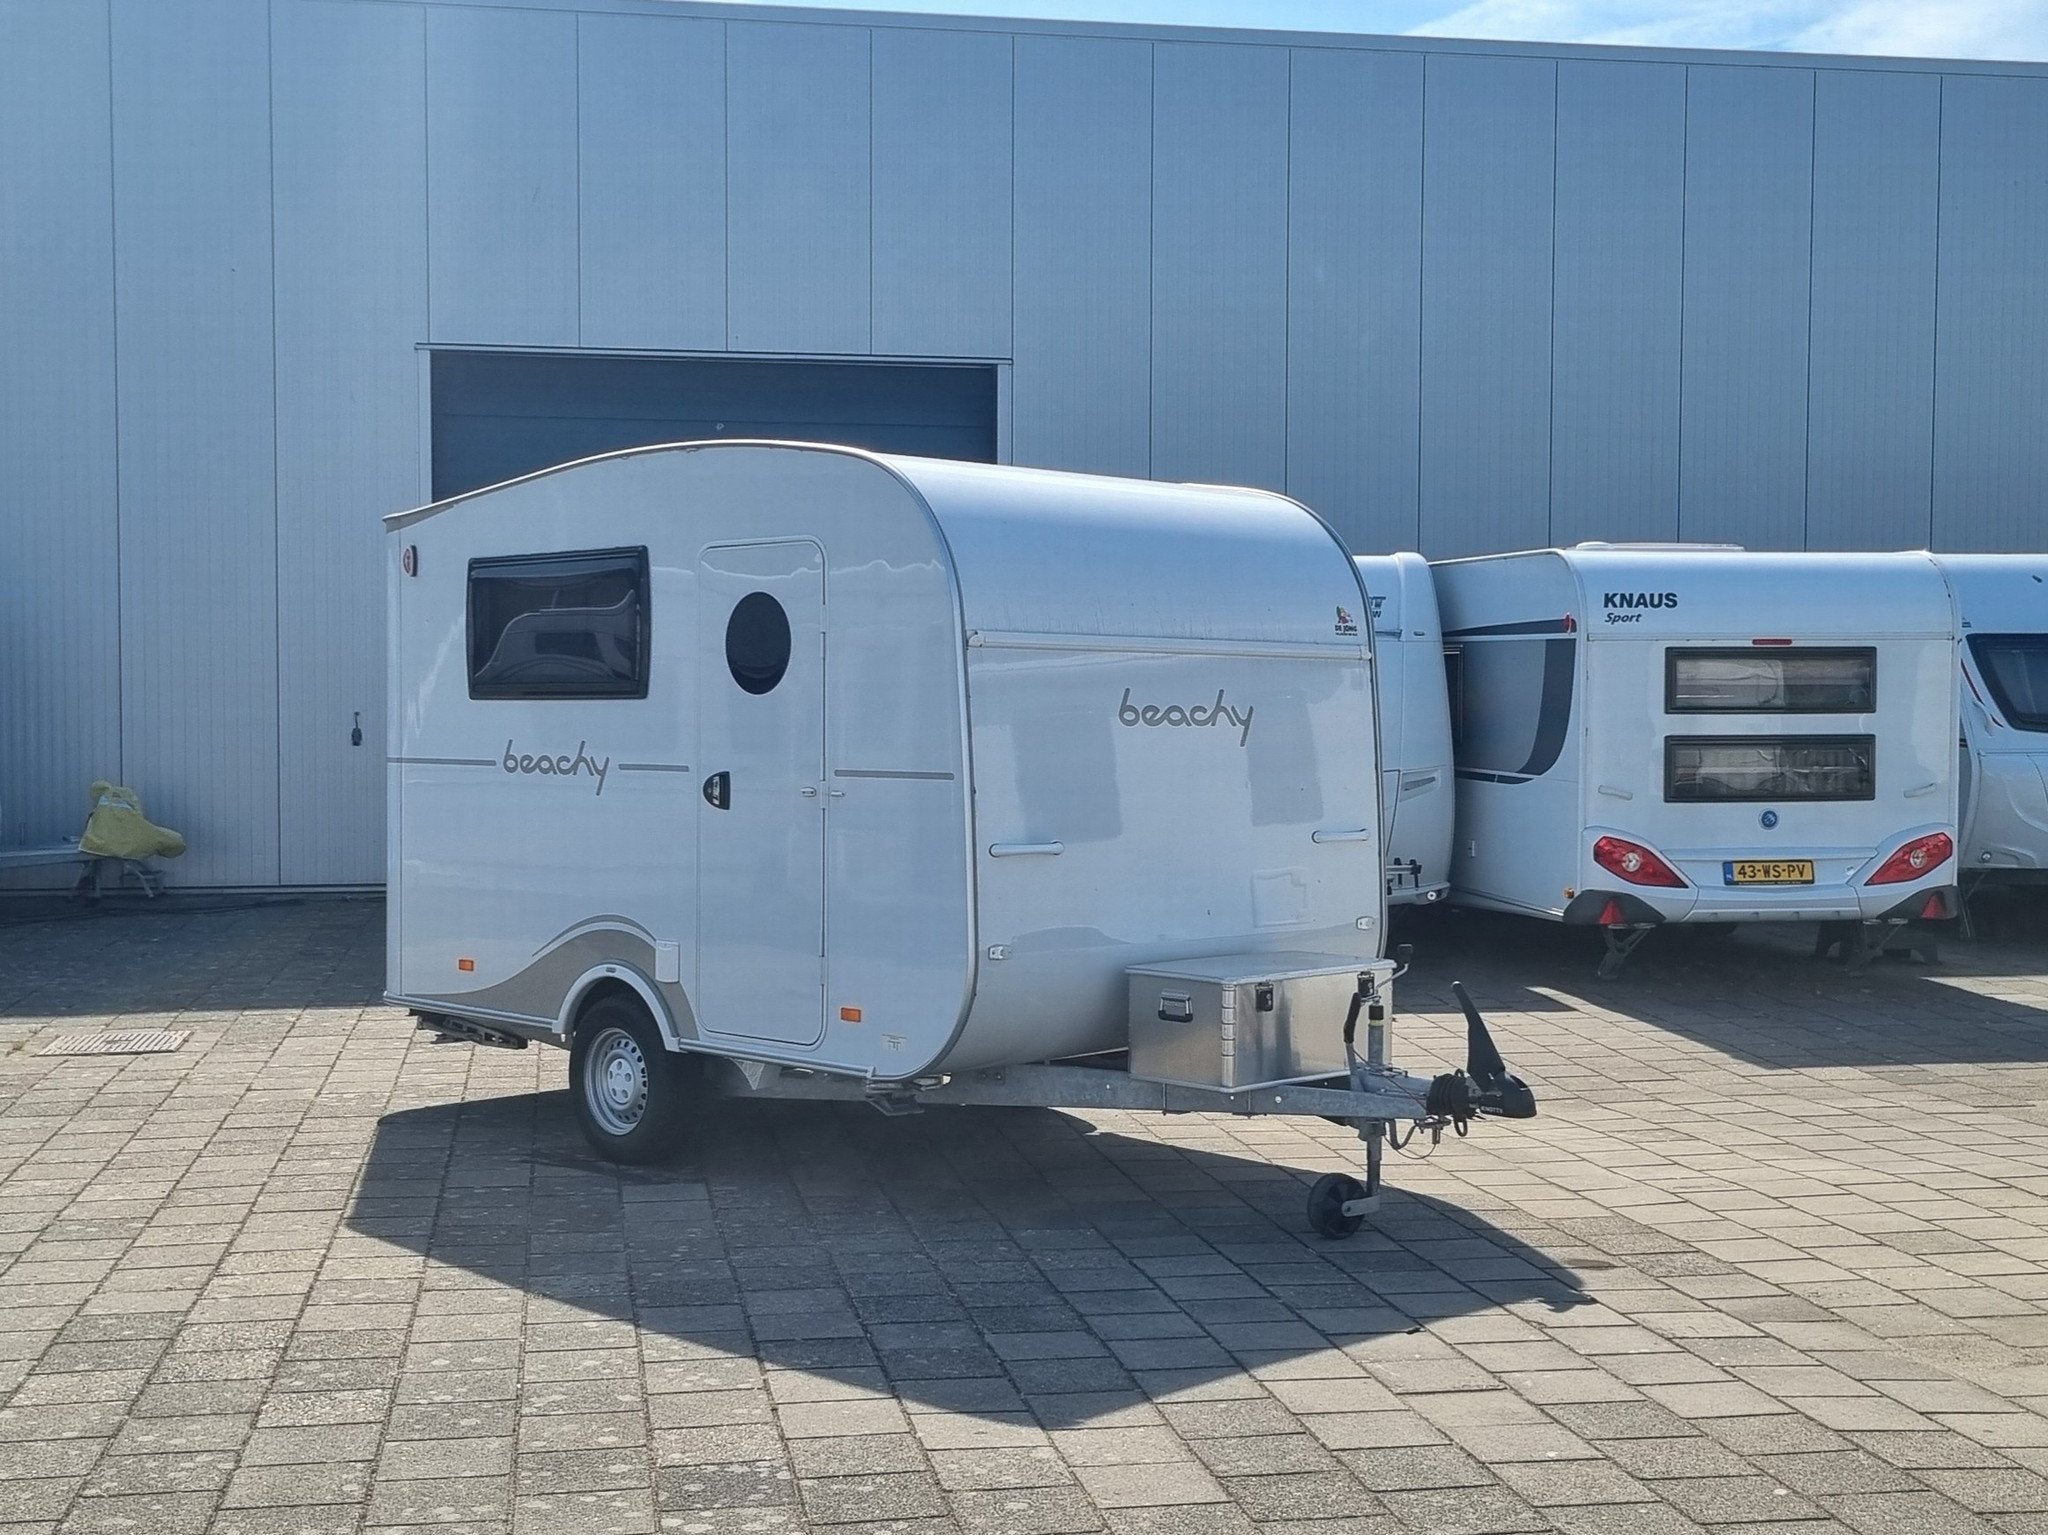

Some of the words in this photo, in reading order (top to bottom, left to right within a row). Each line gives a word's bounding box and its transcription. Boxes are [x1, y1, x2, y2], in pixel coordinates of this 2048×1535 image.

[1603, 592, 1678, 609] KNAUS
[1604, 612, 1642, 626] Sport
[1118, 687, 1254, 747] beachy
[503, 739, 610, 796] beachy
[1738, 864, 1805, 879] 43-WS-PV
